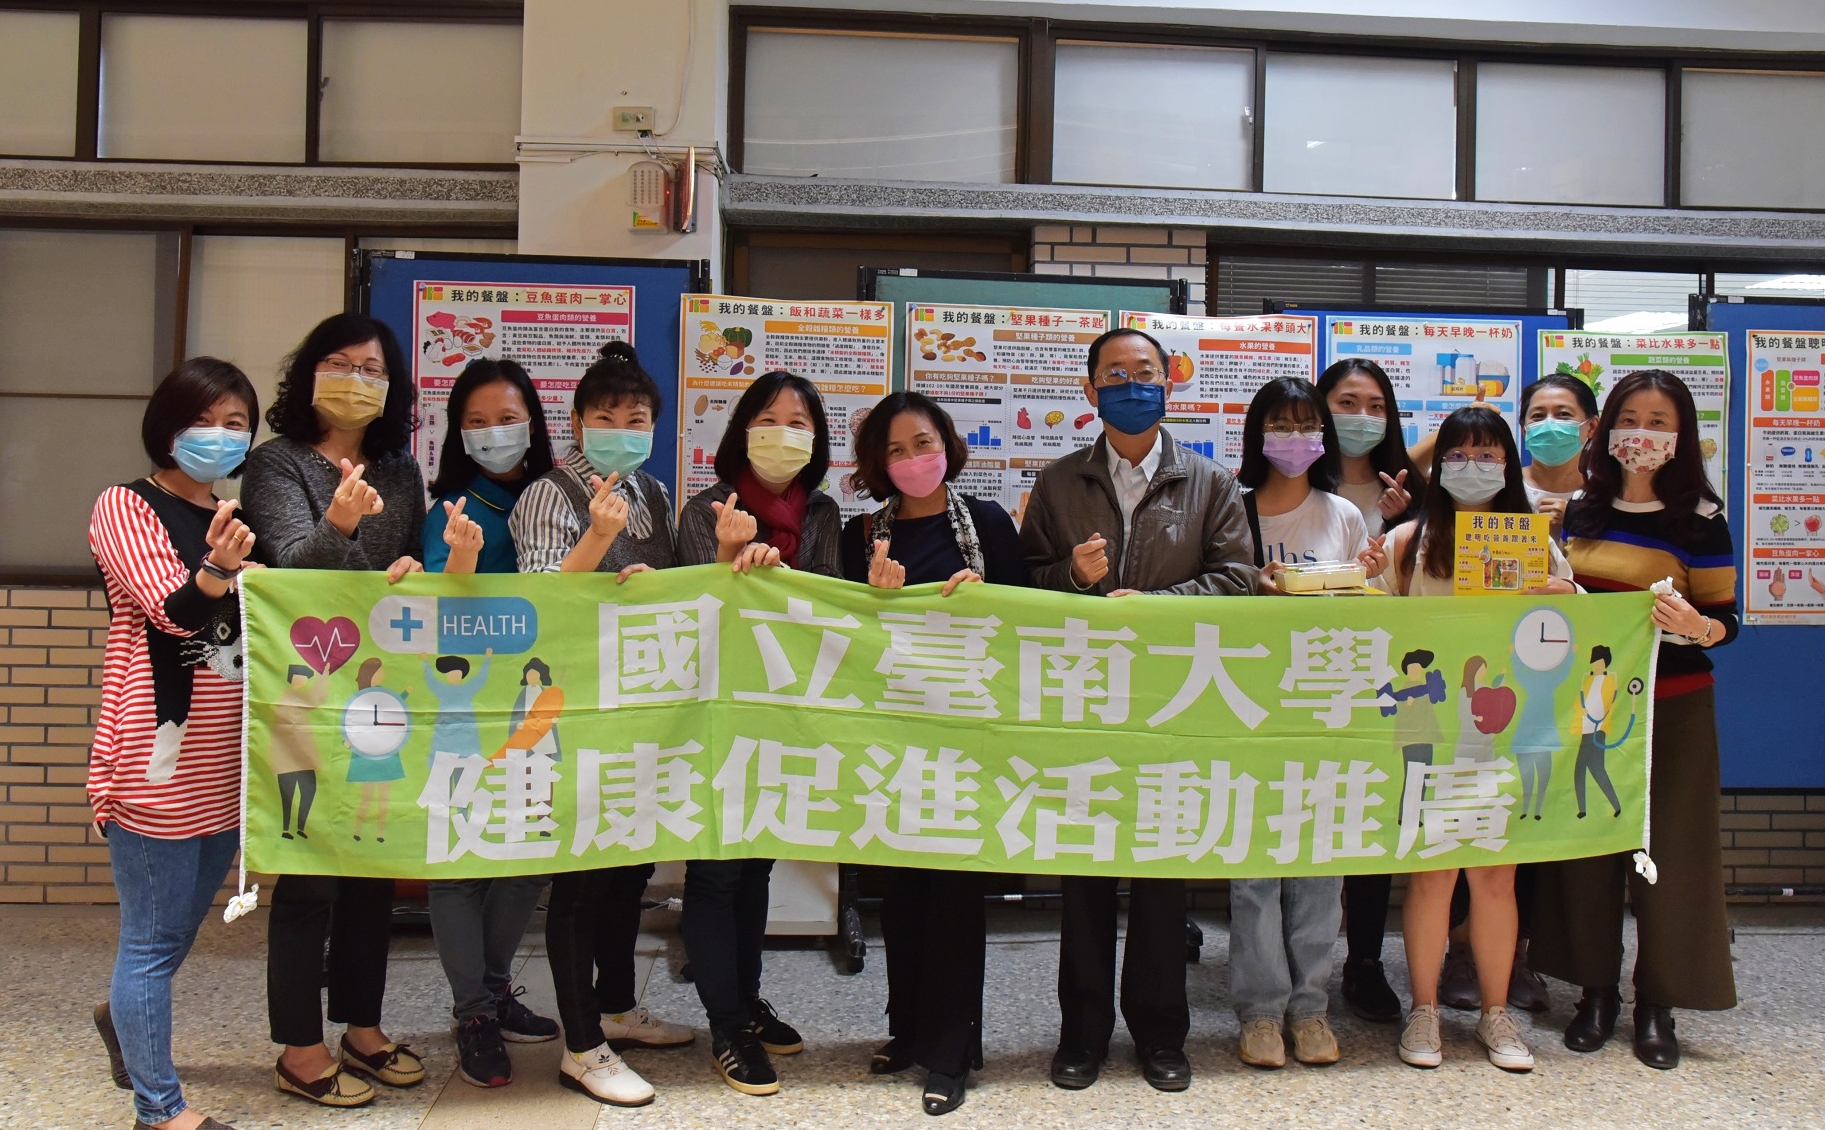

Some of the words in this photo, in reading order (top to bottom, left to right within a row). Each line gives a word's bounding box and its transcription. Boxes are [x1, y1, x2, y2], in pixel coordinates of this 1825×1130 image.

[451, 289, 627, 306] 我的餐盤：豆魚蛋肉一掌心
[537, 313, 597, 322] 豆魚蛋肉類的營養
[718, 302, 886, 321] 我的餐盤：飯和蔬菜一樣多
[942, 311, 1104, 329] 我的餐盤：堅果種子一茶匙
[797, 324, 860, 335] 全穀雜糧類的營養
[1015, 332, 1076, 342] 堅果種子類的營養
[1359, 324, 1513, 339] 我的餐盤：每天早晚一杯奶
[1239, 342, 1276, 351] 水果的營養
[1571, 336, 1720, 350] 我的餐盤：菜比水果多一點
[1472, 515, 1532, 532] 我的餐盤
[443, 614, 526, 636] HEALTH
[598, 592, 1399, 731] 國立臺南大學
[416, 735, 1517, 865] 健康促進活動推廣
